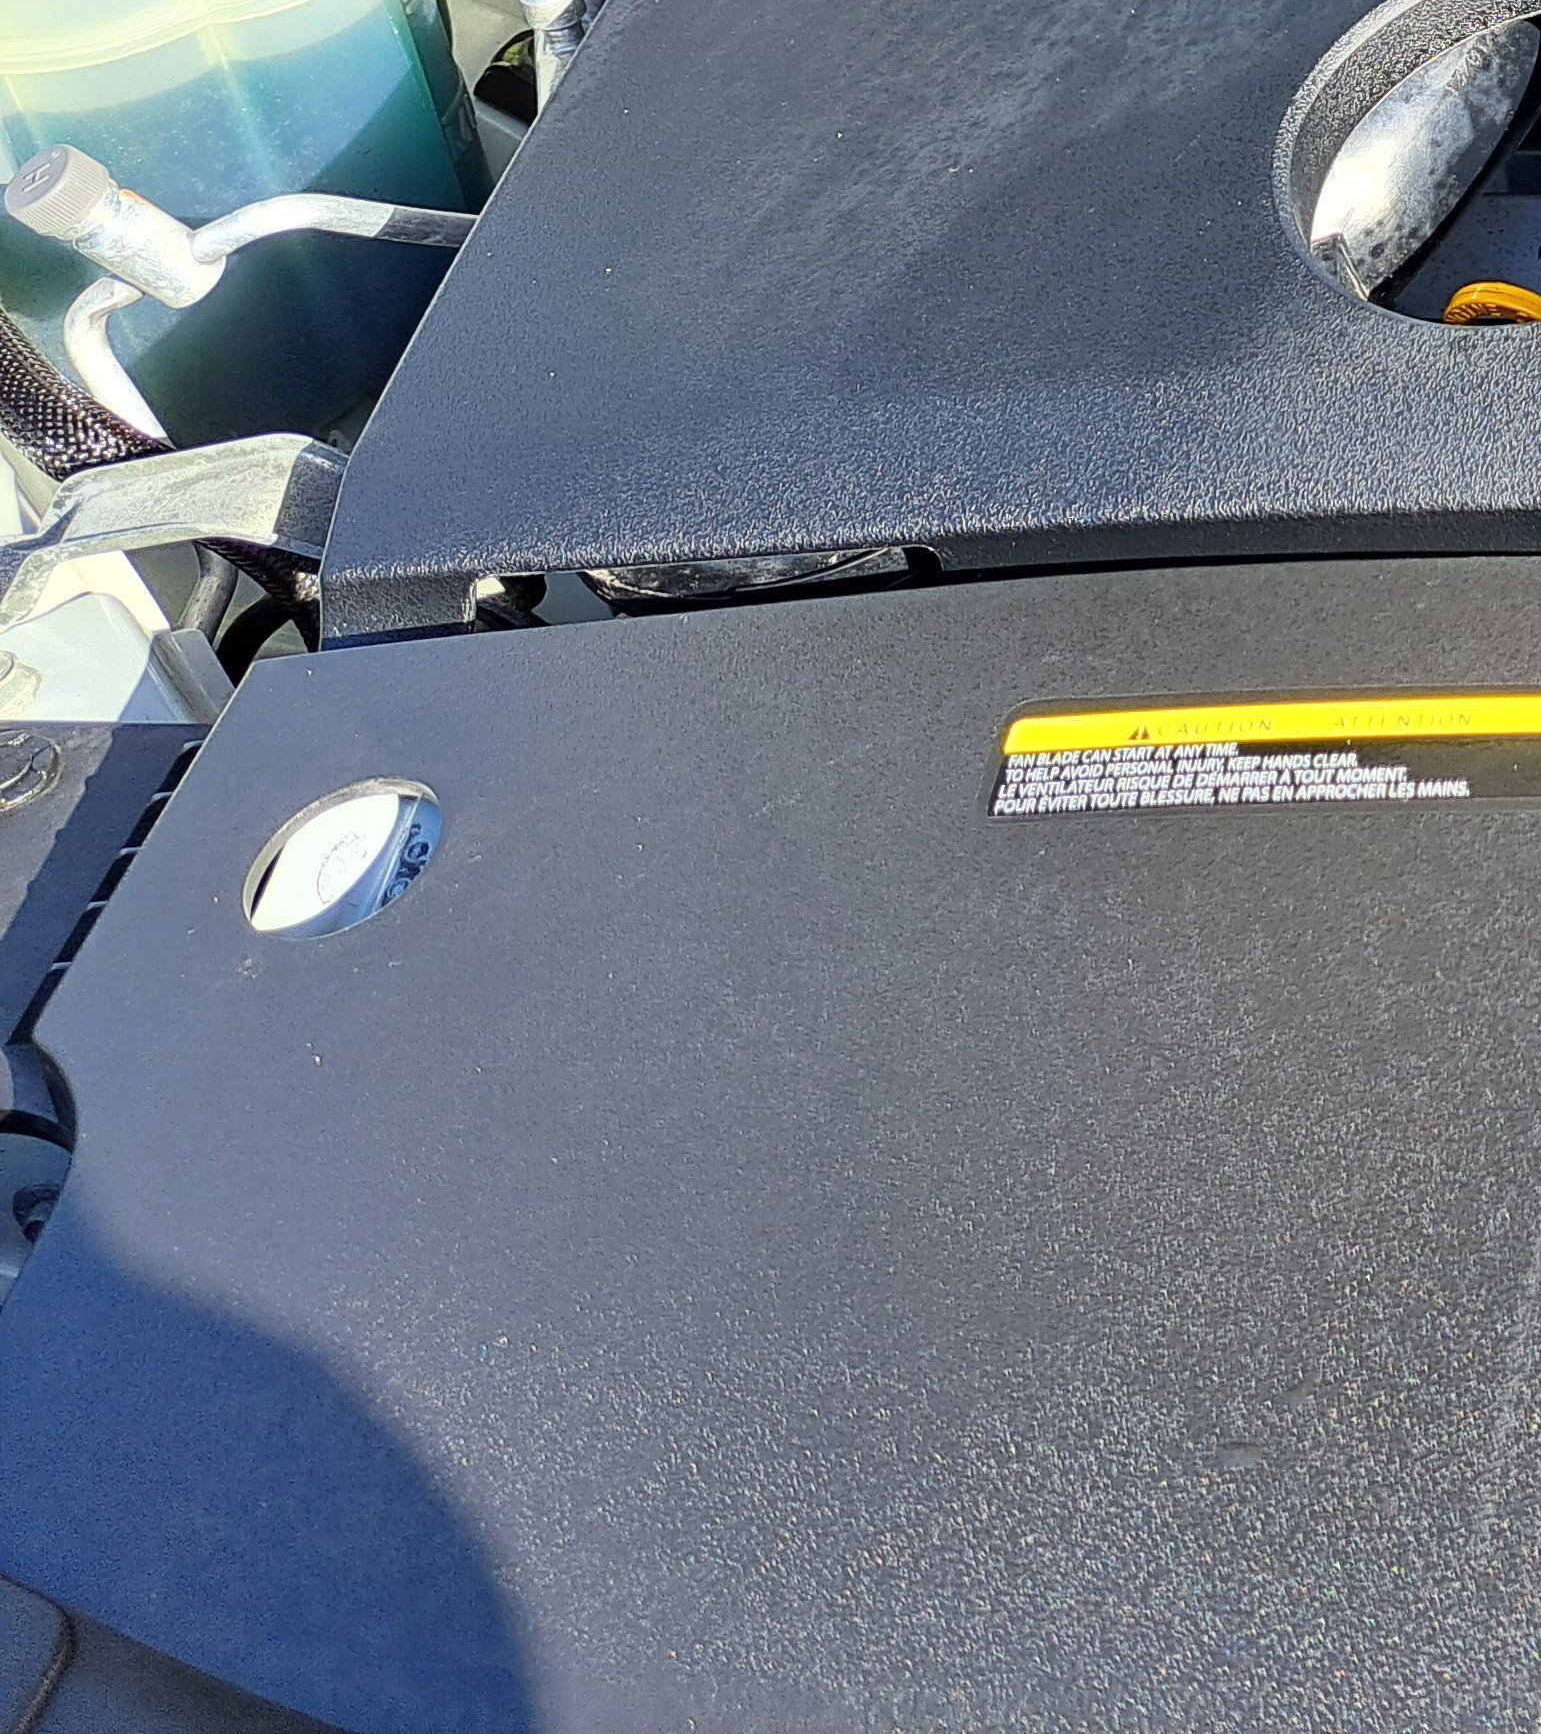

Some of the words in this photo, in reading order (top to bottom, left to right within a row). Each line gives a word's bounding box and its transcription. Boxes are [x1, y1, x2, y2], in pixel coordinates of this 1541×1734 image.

[22, 162, 52, 193] H
[1157, 719, 1273, 738] CAUTION
[1332, 713, 1472, 729] ATTENTION
[1006, 768, 1024, 783] TO
[1025, 766, 1061, 782] HELP
[1060, 764, 1104, 781] AVOID
[1228, 756, 1262, 772] KEEP
[1262, 754, 1311, 771] HANDS
[1008, 754, 1035, 769] FAN
[1036, 751, 1080, 767] BLADE
[1081, 749, 1112, 764] CAN
[1113, 746, 1155, 762] START
[1154, 745, 1174, 760] AT
[1173, 743, 1206, 758] ANY
[994, 799, 1040, 816] POUR
[1089, 792, 1139, 811] TOUTE
[1218, 788, 1241, 804] NE
[1241, 785, 1270, 803] PAS
[1272, 784, 1295, 801] EN
[1295, 781, 1388, 801] APPROCHER
[1389, 781, 1416, 798] LES
[999, 784, 1017, 799] LE
[1018, 778, 1115, 798] VENTILATEUR
[1116, 774, 1170, 794] RISQUE
[1172, 773, 1195, 789] DE
[1195, 770, 1278, 789] DÉMARRER
[1293, 769, 1336, 785] TOUT
